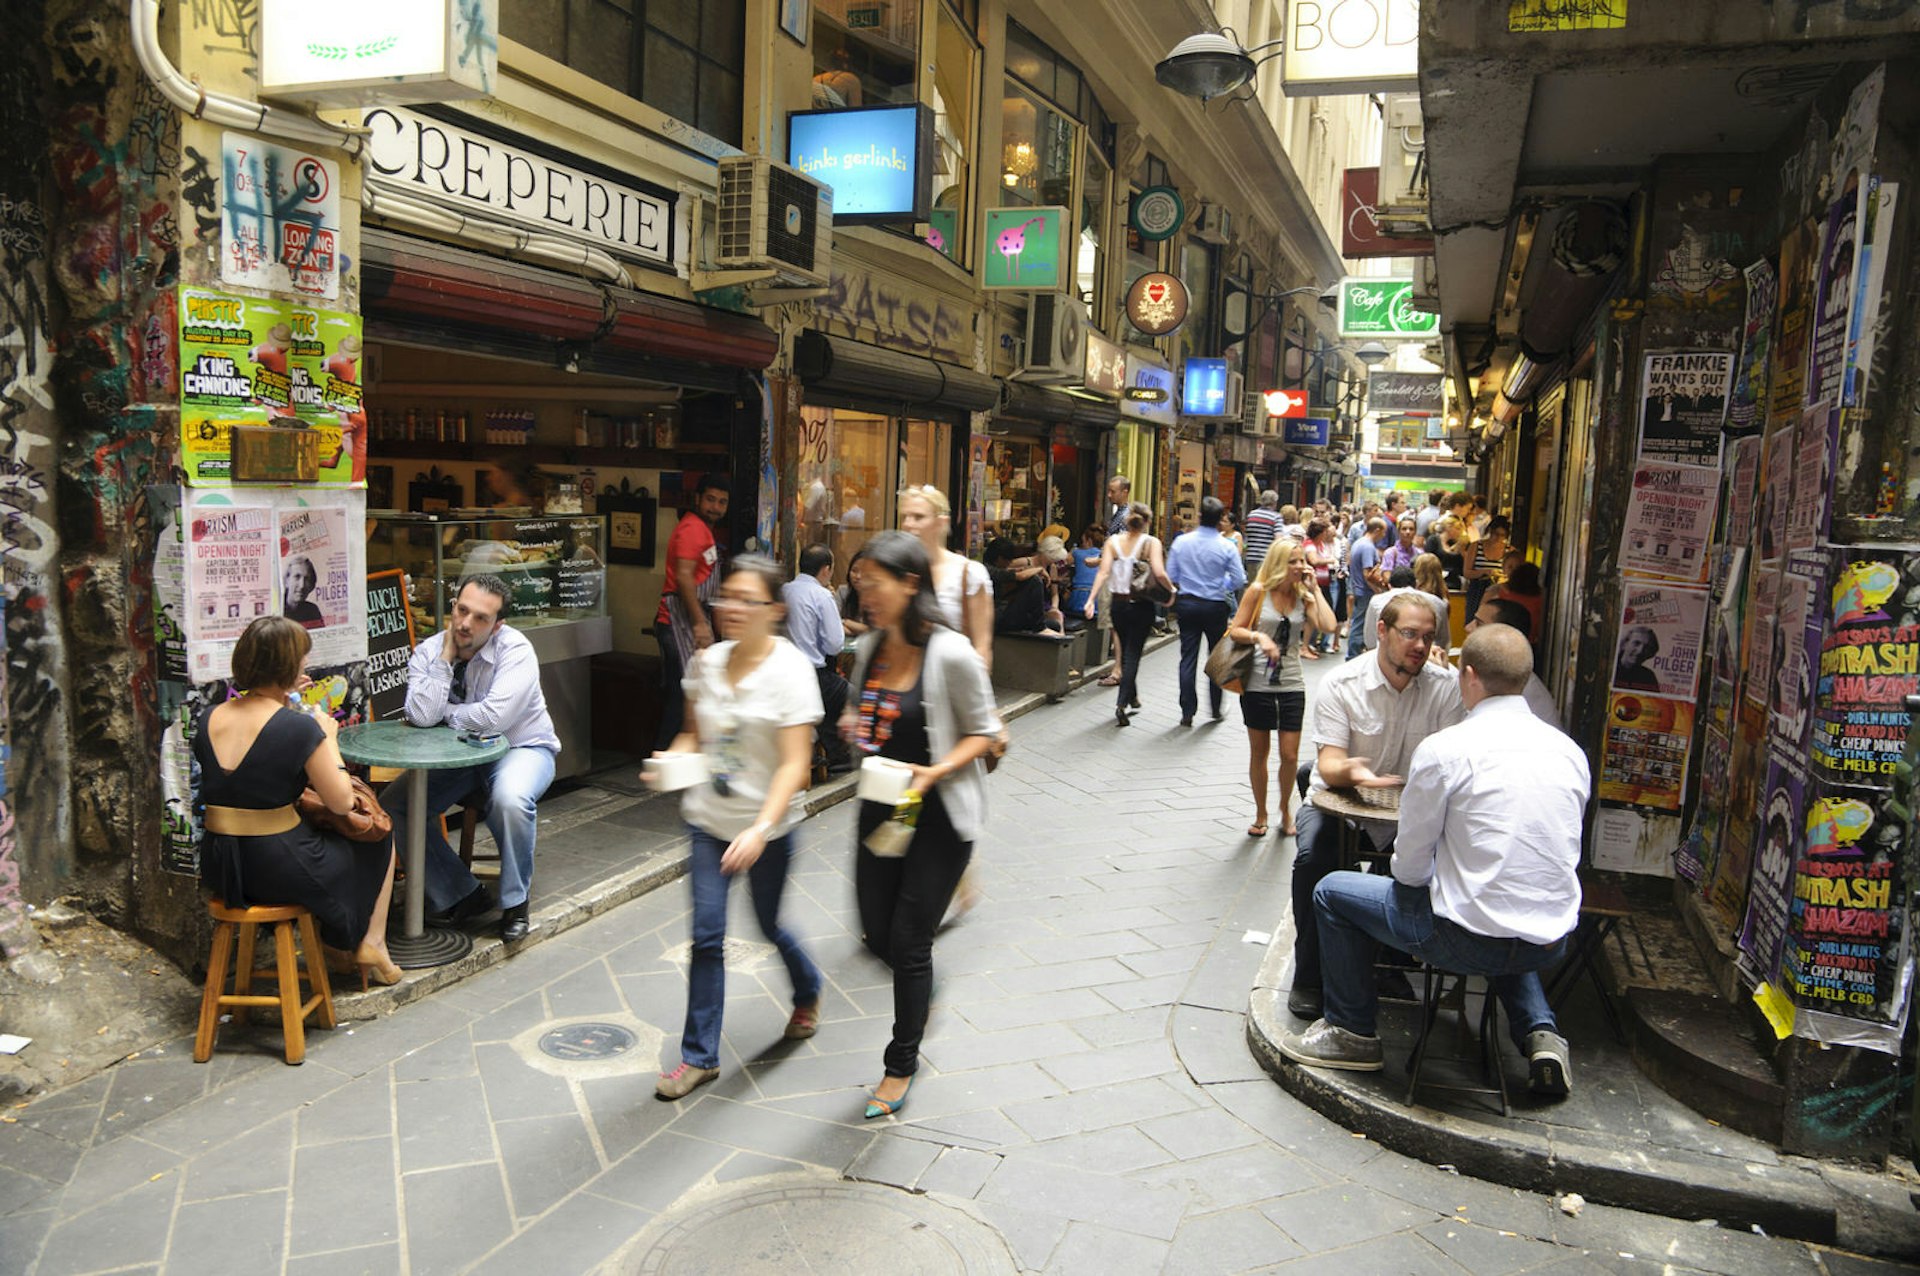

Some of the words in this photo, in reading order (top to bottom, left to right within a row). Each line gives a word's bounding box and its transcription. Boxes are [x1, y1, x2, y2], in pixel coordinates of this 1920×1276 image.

[363, 109, 659, 251] CREPERIE
[285, 229, 333, 251] LOAING
[199, 357, 235, 377] KING
[1651, 356, 1728, 372] FRANKIE
[184, 373, 251, 397] CANNONS
[1649, 372, 1696, 387] WANTS
[1701, 374, 1727, 385] OUT
[1641, 470, 1681, 485] ARXISM
[1637, 491, 1677, 506] OPENING
[1678, 496, 1708, 511] NIGHT
[197, 514, 238, 536] ARXISM
[197, 545, 238, 558] OPENING
[239, 544, 267, 557] NIGHT
[228, 574, 260, 583] CENTURY
[327, 570, 348, 585] JOHN
[316, 583, 349, 601] PILGER
[366, 586, 400, 613] UNCH
[366, 610, 407, 638] PECIALS
[1670, 646, 1698, 660] JOHN
[1653, 657, 1696, 673] PILGER
[1840, 737, 1872, 752] CHEAP
[1873, 739, 1906, 754] DRINKS
[1880, 763, 1897, 775] CB
[1804, 904, 1889, 938] SHAZAM
[1811, 965, 1843, 979] CHEAP
[1848, 992, 1875, 1005] CBD
